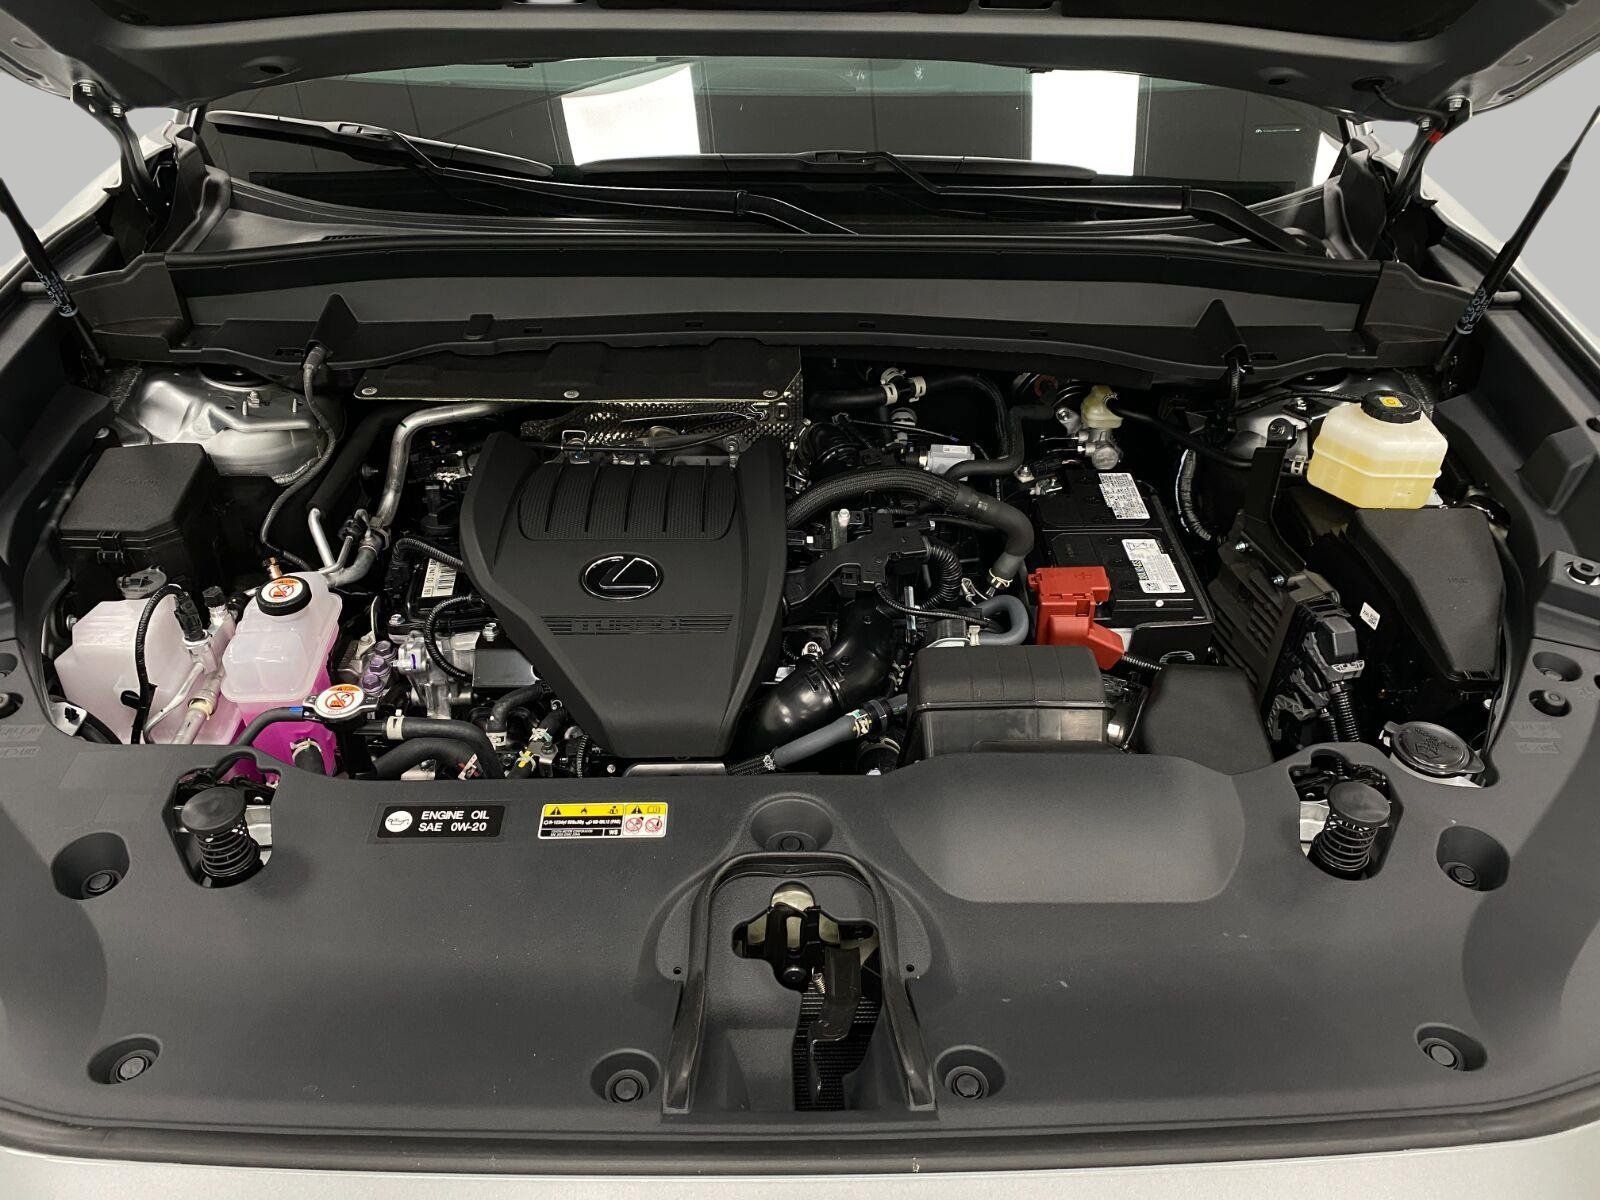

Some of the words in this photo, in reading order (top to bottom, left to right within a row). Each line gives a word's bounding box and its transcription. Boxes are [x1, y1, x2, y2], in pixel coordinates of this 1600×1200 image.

[421, 810, 464, 820] ENGINE
[470, 810, 490, 820] OIL
[418, 822, 443, 832] SAE
[450, 822, 487, 832] 0W-20
